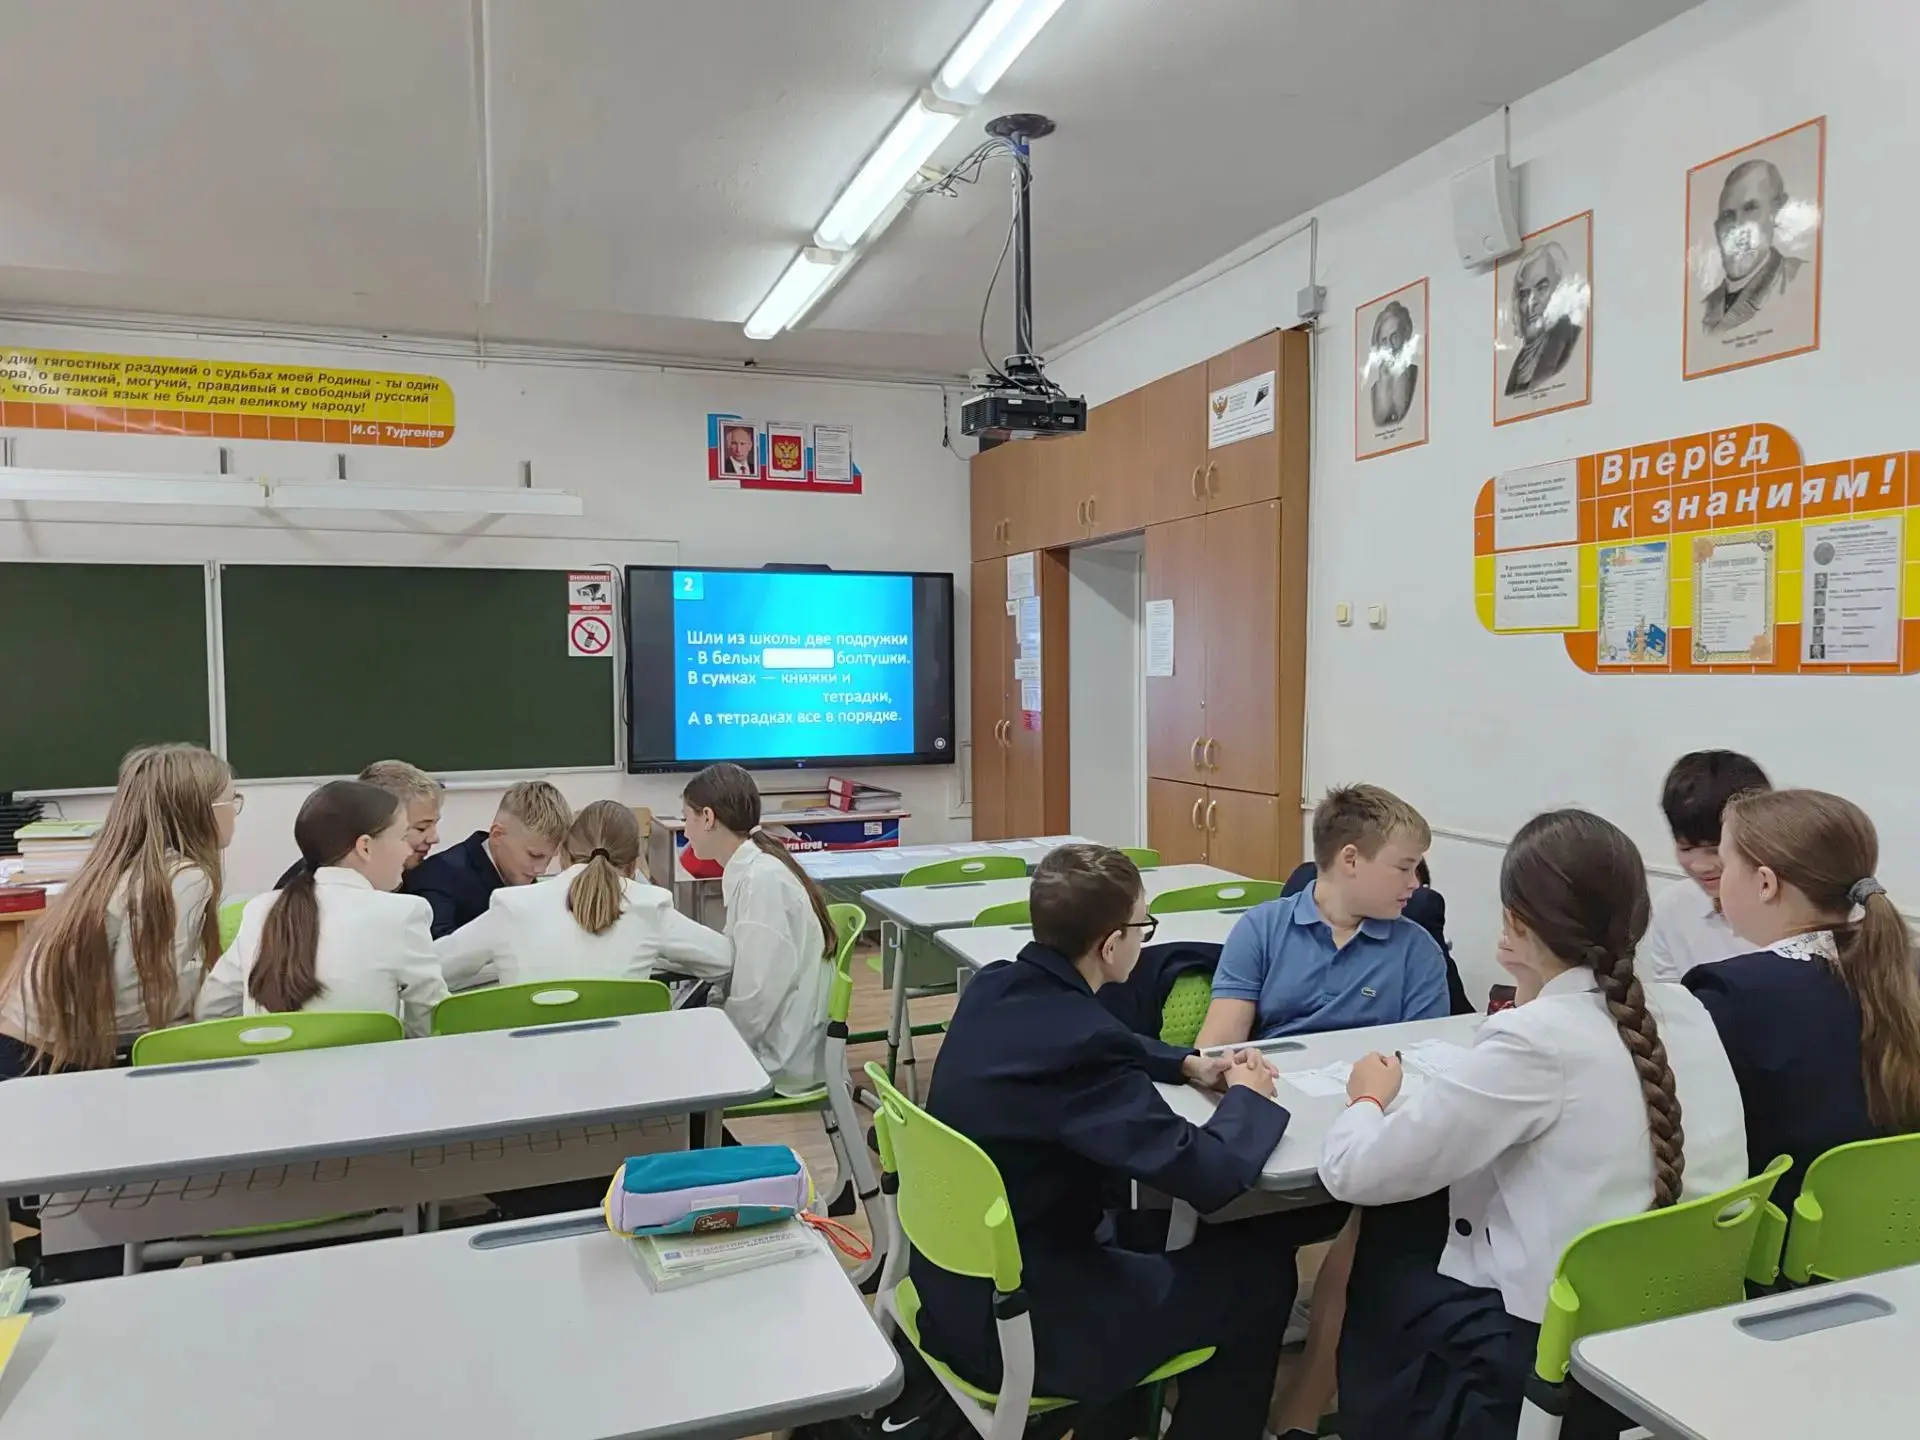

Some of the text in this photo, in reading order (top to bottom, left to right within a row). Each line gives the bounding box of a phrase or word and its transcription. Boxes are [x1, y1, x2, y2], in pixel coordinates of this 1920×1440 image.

[7, 355, 37, 365] дни
[43, 357, 121, 371] тягостных
[125, 362, 198, 375] раздумий
[202, 367, 211, 376] о
[216, 367, 273, 380] судьбах
[277, 371, 313, 383] моей
[318, 373, 370, 386] Родины
[386, 379, 402, 389] ты
[406, 380, 439, 391] один
[38, 371, 48, 380] о
[53, 371, 121, 386] великий,
[126, 375, 191, 390] могучий,
[197, 381, 276, 394] правдивый
[281, 386, 290, 395] и
[294, 386, 371, 399] свободный
[374, 391, 429, 403] русский
[12, 383, 60, 396] чтобы
[66, 386, 108, 398] такой
[113, 390, 149, 401] язык
[153, 392, 170, 401] не
[176, 391, 204, 403] был
[208, 395, 235, 405] дан
[240, 396, 307, 411] великому
[312, 401, 366, 414] народу!
[385, 425, 445, 438] Тургенев
[1600, 431, 1770, 485] Вперёд
[1611, 458, 1897, 529] к знаниям!
[684, 578, 694, 591] 2
[687, 630, 908, 648] Шли из школы две подружки
[698, 651, 708, 665] В
[713, 650, 760, 665] белых
[836, 650, 911, 665] болтушки.
[688, 671, 698, 684] В
[702, 673, 756, 687] сумках
[781, 671, 837, 684] книжки
[842, 672, 851, 683] и
[822, 690, 892, 705] тетрадки,
[688, 710, 902, 726] А в тетрадках все в порядке.
